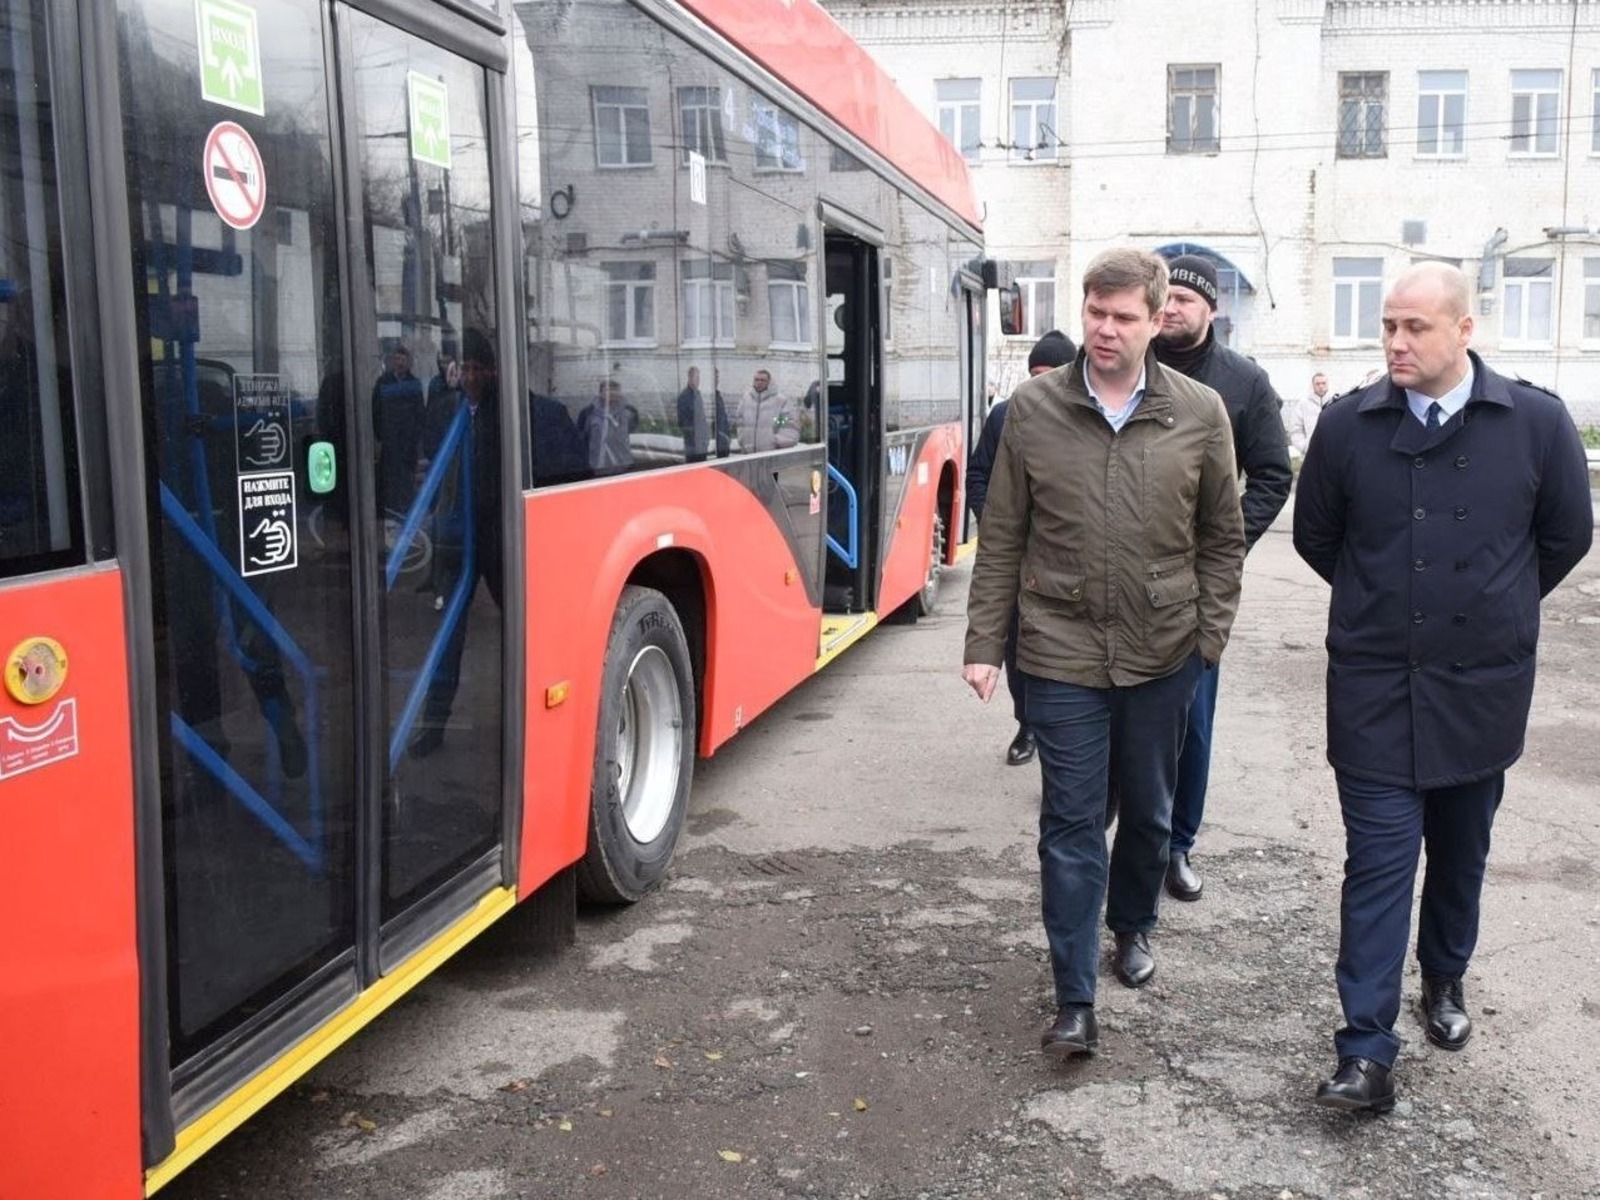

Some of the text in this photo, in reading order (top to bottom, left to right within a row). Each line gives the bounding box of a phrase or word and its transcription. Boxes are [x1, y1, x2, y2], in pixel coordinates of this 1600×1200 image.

[212, 24, 246, 52] ВХОД
[243, 478, 289, 492] НАЖМИТЕ
[245, 493, 292, 510] ДЛЯ ВХОДА
